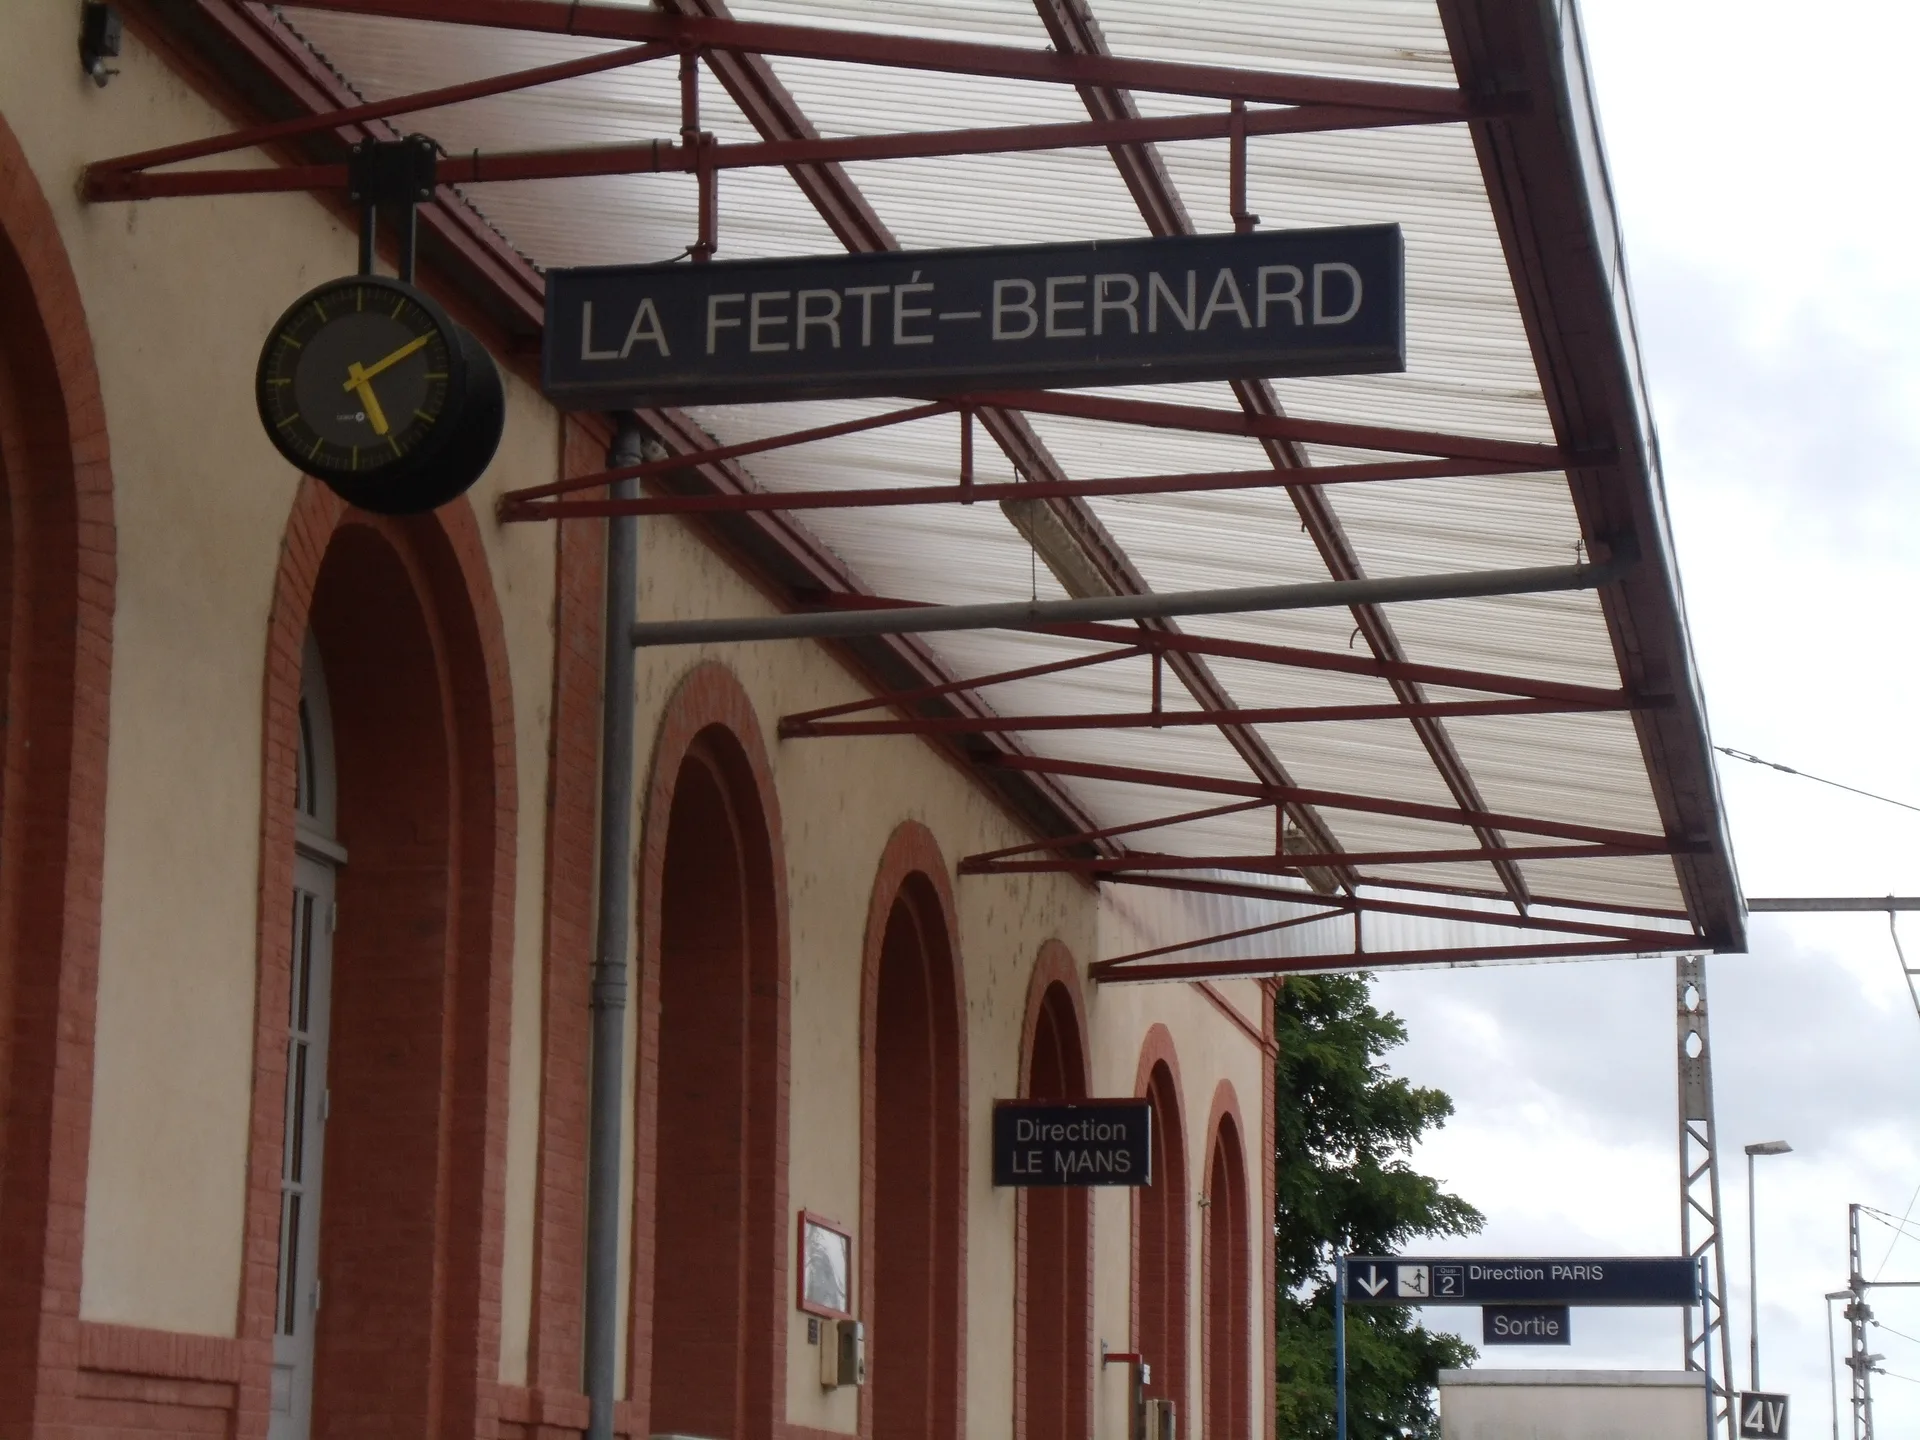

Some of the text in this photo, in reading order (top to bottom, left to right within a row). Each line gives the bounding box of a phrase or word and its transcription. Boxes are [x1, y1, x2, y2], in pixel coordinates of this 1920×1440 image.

[580, 297, 671, 361] LA
[1016, 1118, 1127, 1141] Direction
[1012, 1149, 1132, 1174] LE MANS
[1470, 1265, 1604, 1280] Direction PARIS
[1442, 1276, 1455, 1294] 2
[1494, 1315, 1559, 1336] Sortie
[1744, 1400, 1784, 1434] 4V
